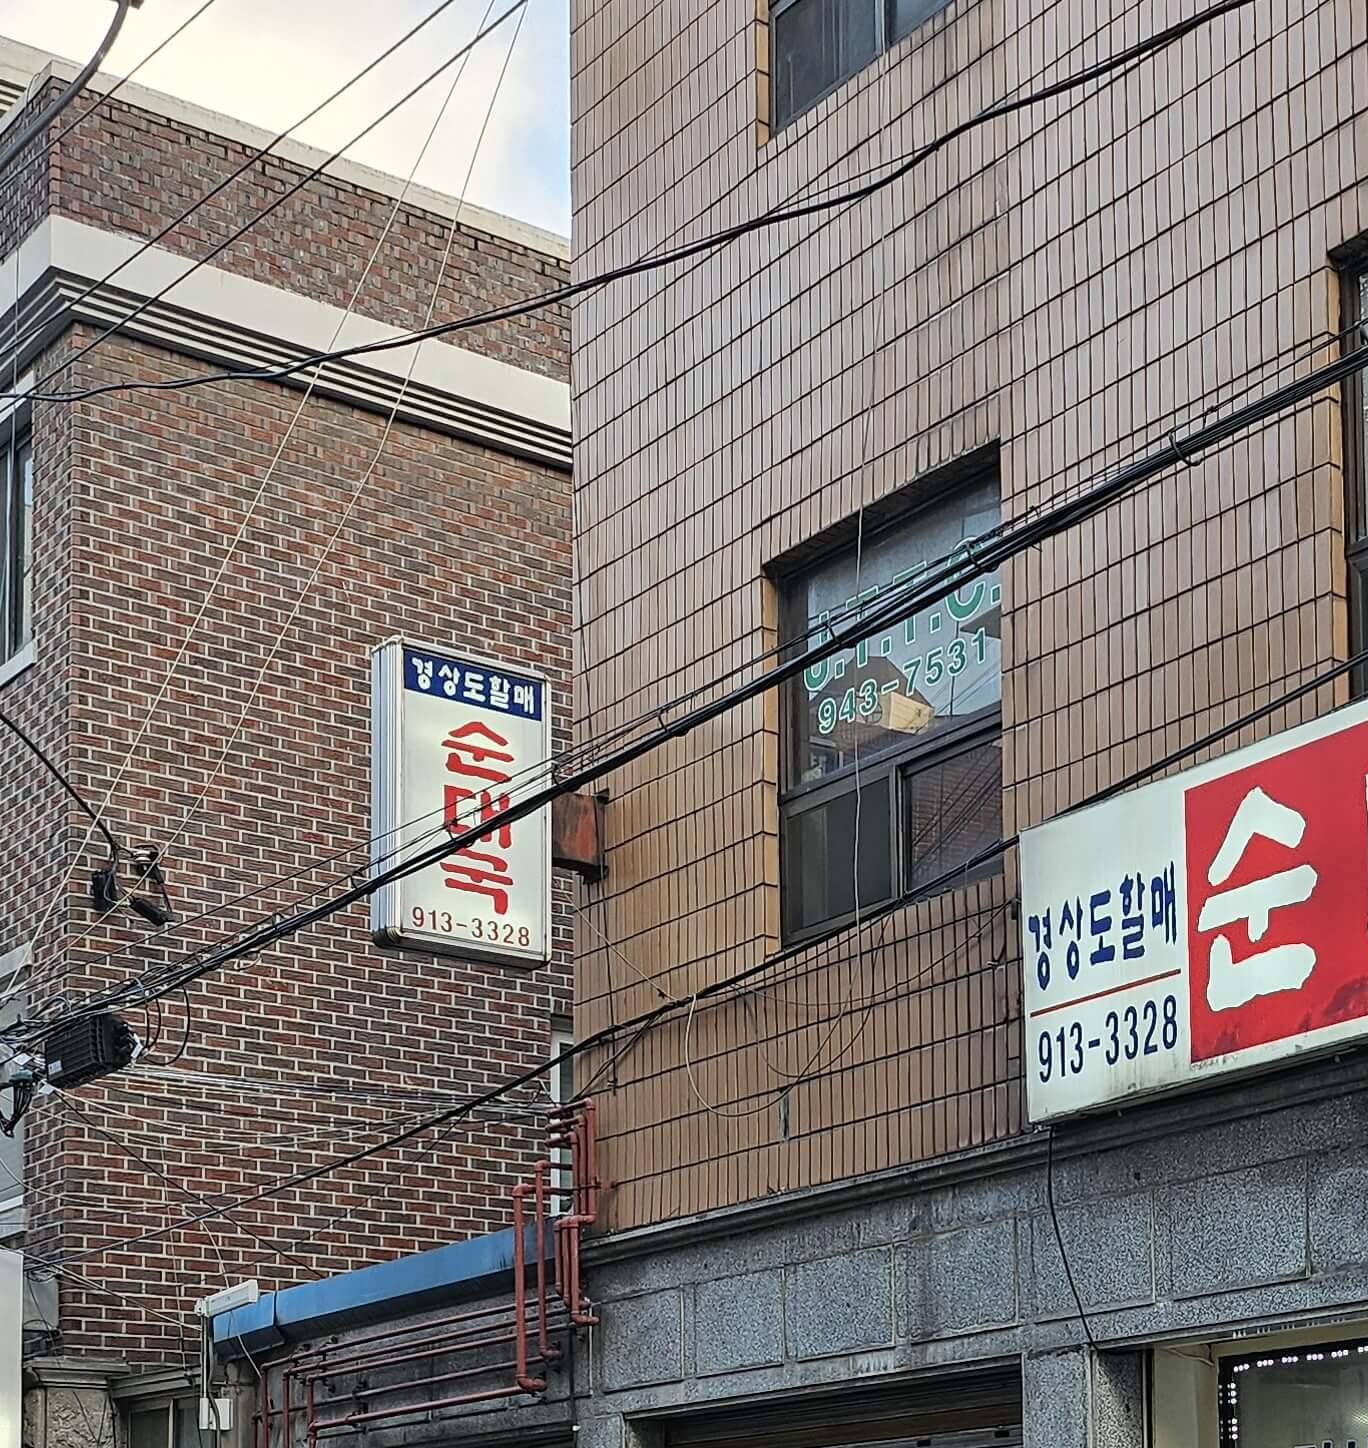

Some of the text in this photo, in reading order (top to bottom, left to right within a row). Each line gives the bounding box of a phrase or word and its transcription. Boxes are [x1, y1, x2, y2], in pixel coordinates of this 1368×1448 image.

[411, 655, 536, 716] 경상도할매
[817, 626, 987, 735] 943-7531
[440, 720, 516, 916] 순대국
[410, 905, 533, 949] 913-3328
[1028, 860, 1178, 992] 경상도할매
[1038, 994, 1179, 1083] 913-3328
